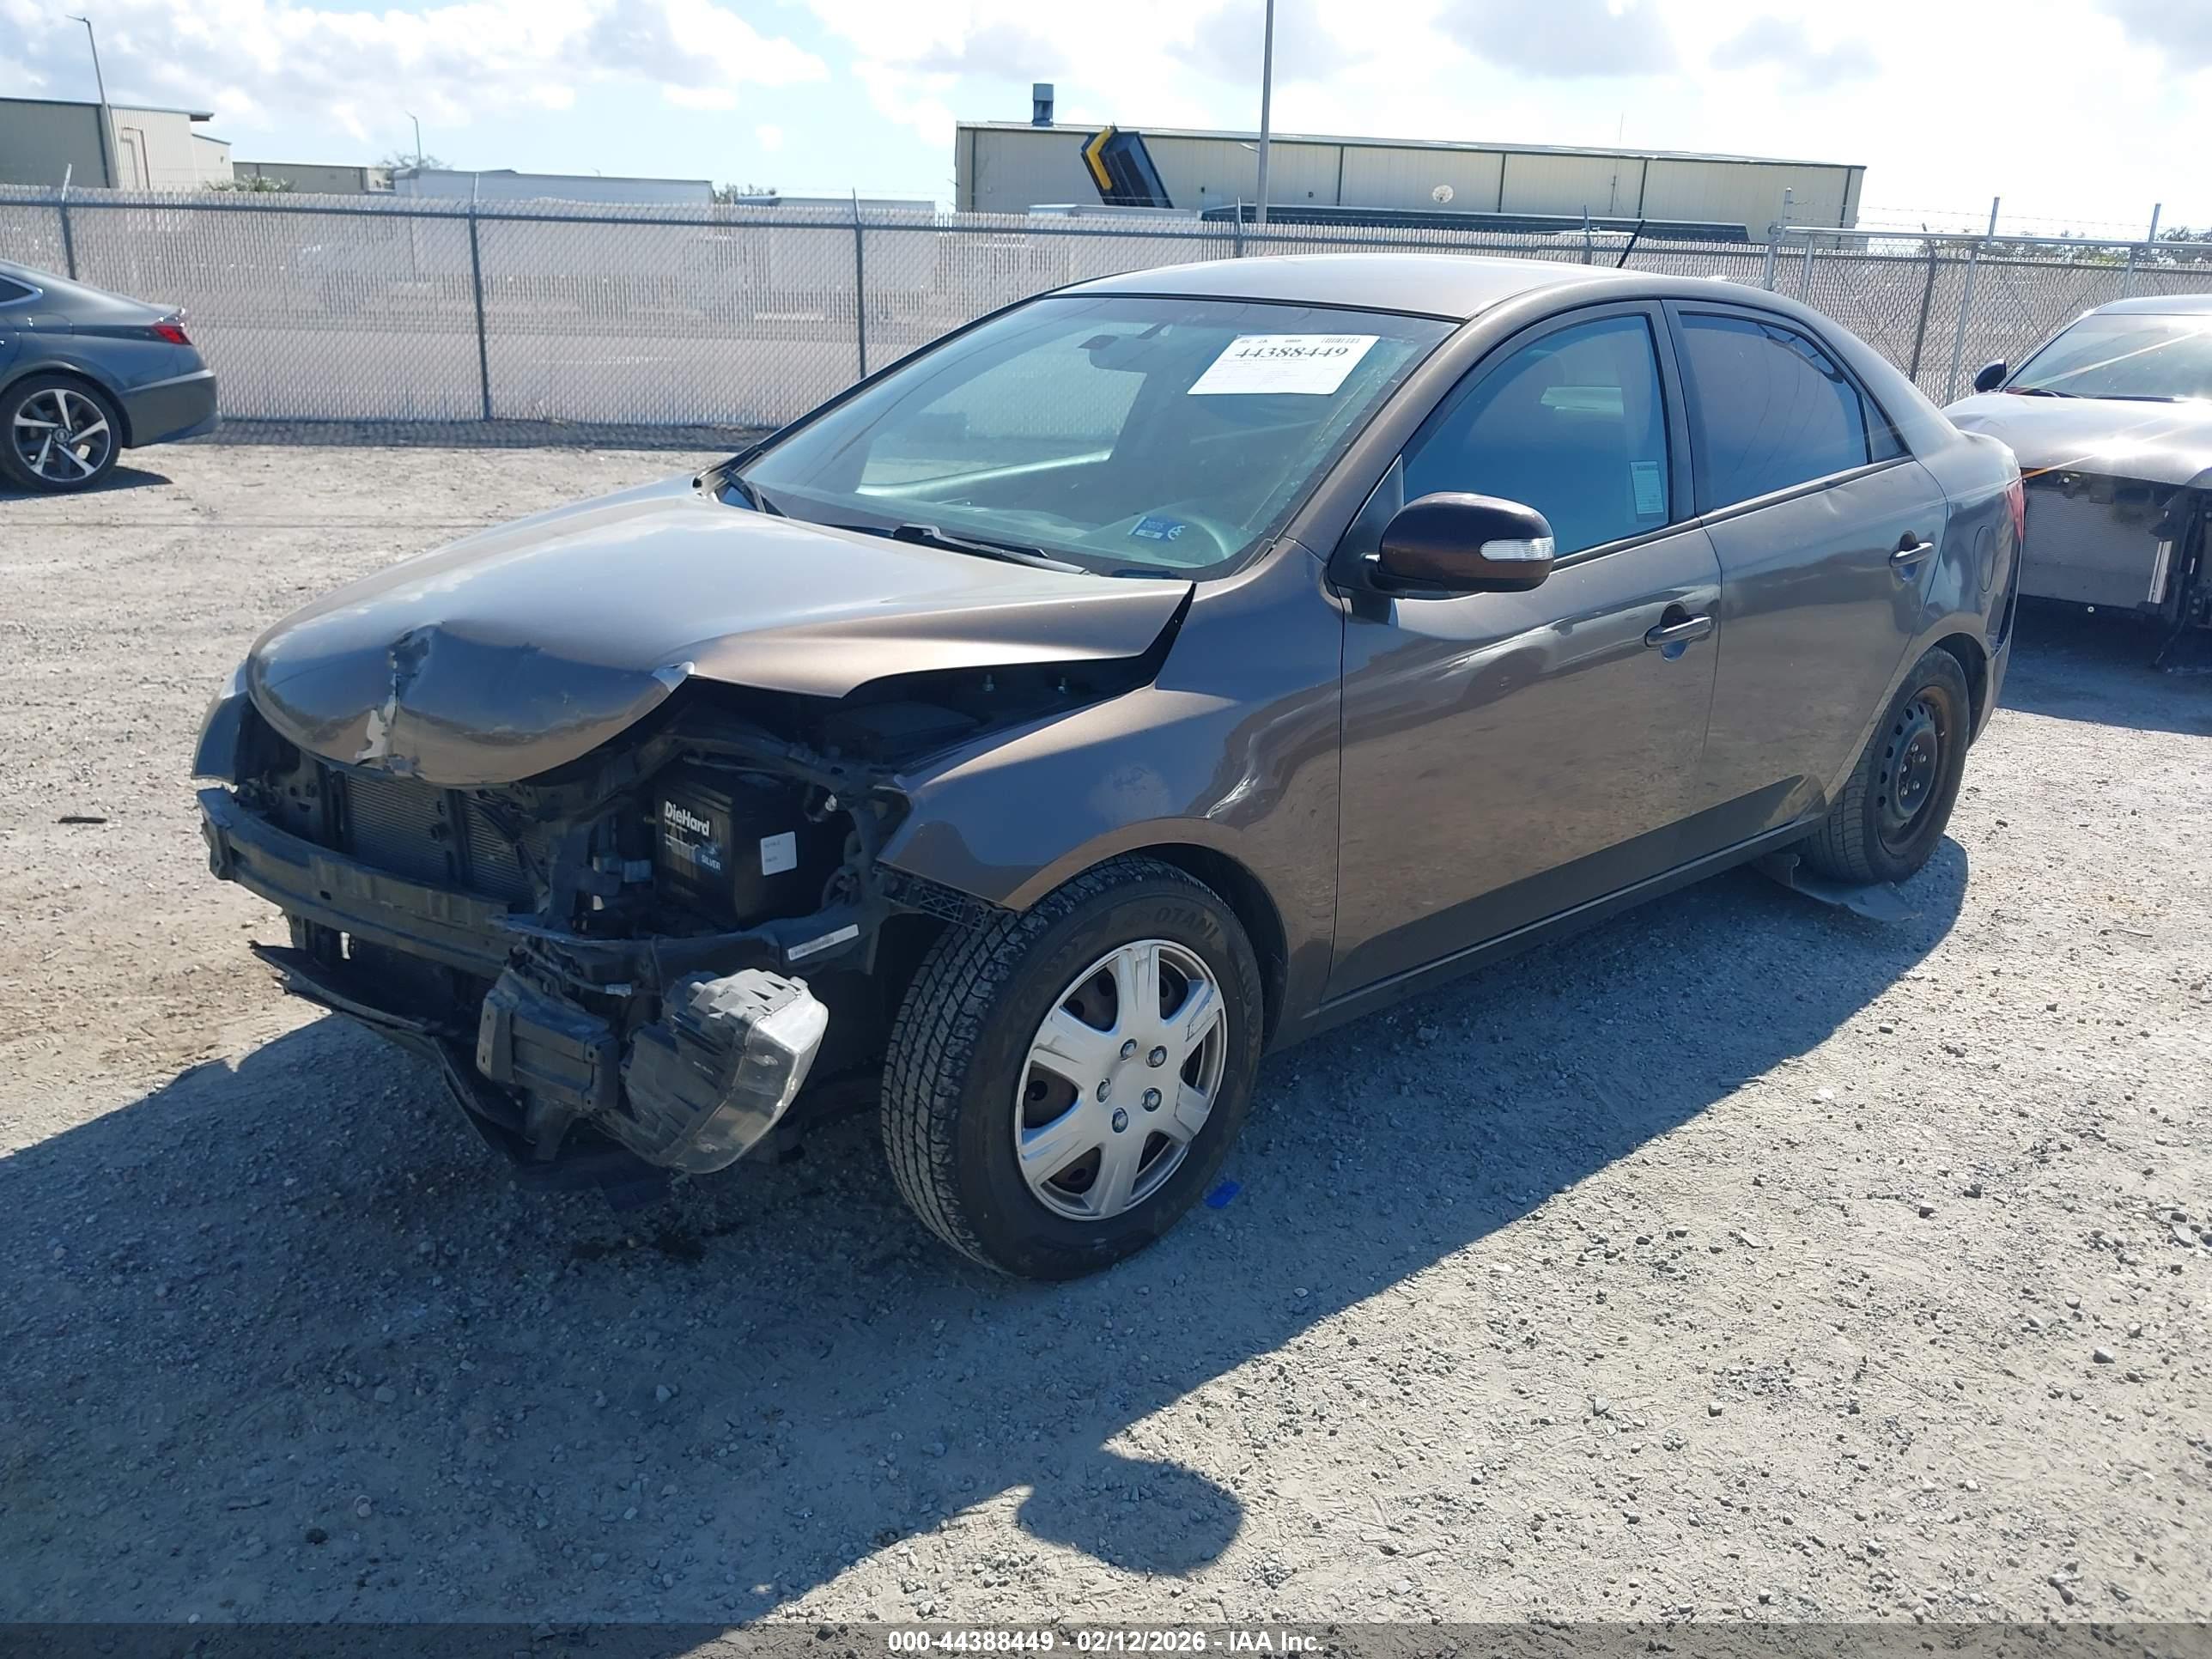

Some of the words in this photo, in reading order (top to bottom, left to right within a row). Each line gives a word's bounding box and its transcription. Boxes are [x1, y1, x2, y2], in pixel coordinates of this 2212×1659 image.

[1235, 346, 1349, 358] 44388449
[665, 800, 710, 837] DieHard
[701, 854, 721, 871] SILVER
[1156, 908, 1219, 939] OTANI
